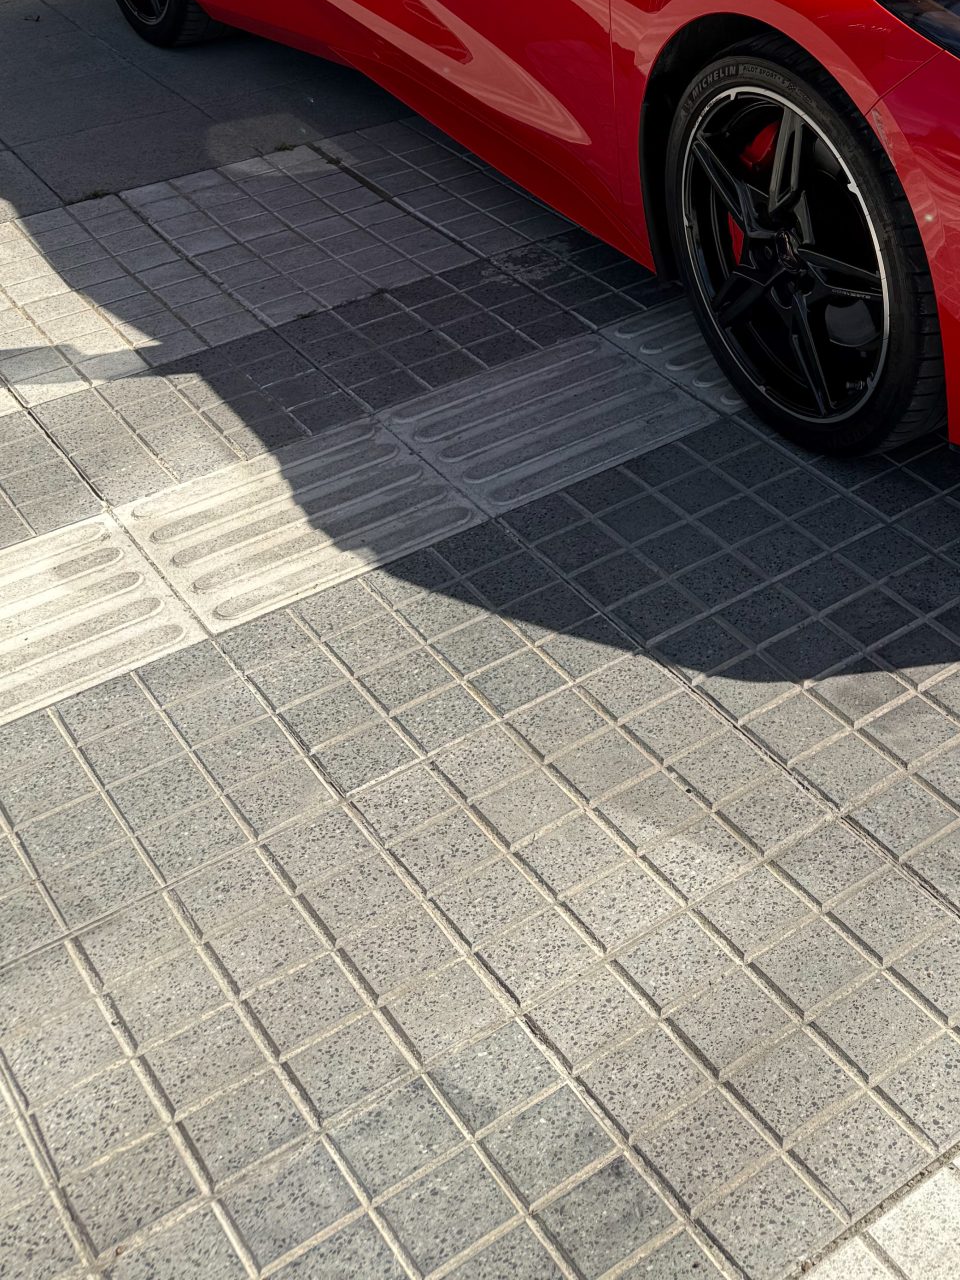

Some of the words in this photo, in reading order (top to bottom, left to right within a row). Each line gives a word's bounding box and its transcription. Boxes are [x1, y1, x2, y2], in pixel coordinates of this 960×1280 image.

[691, 65, 736, 101] MICHELIN
[743, 65, 758, 74] PILOT
[759, 68, 777, 80] SPORT
